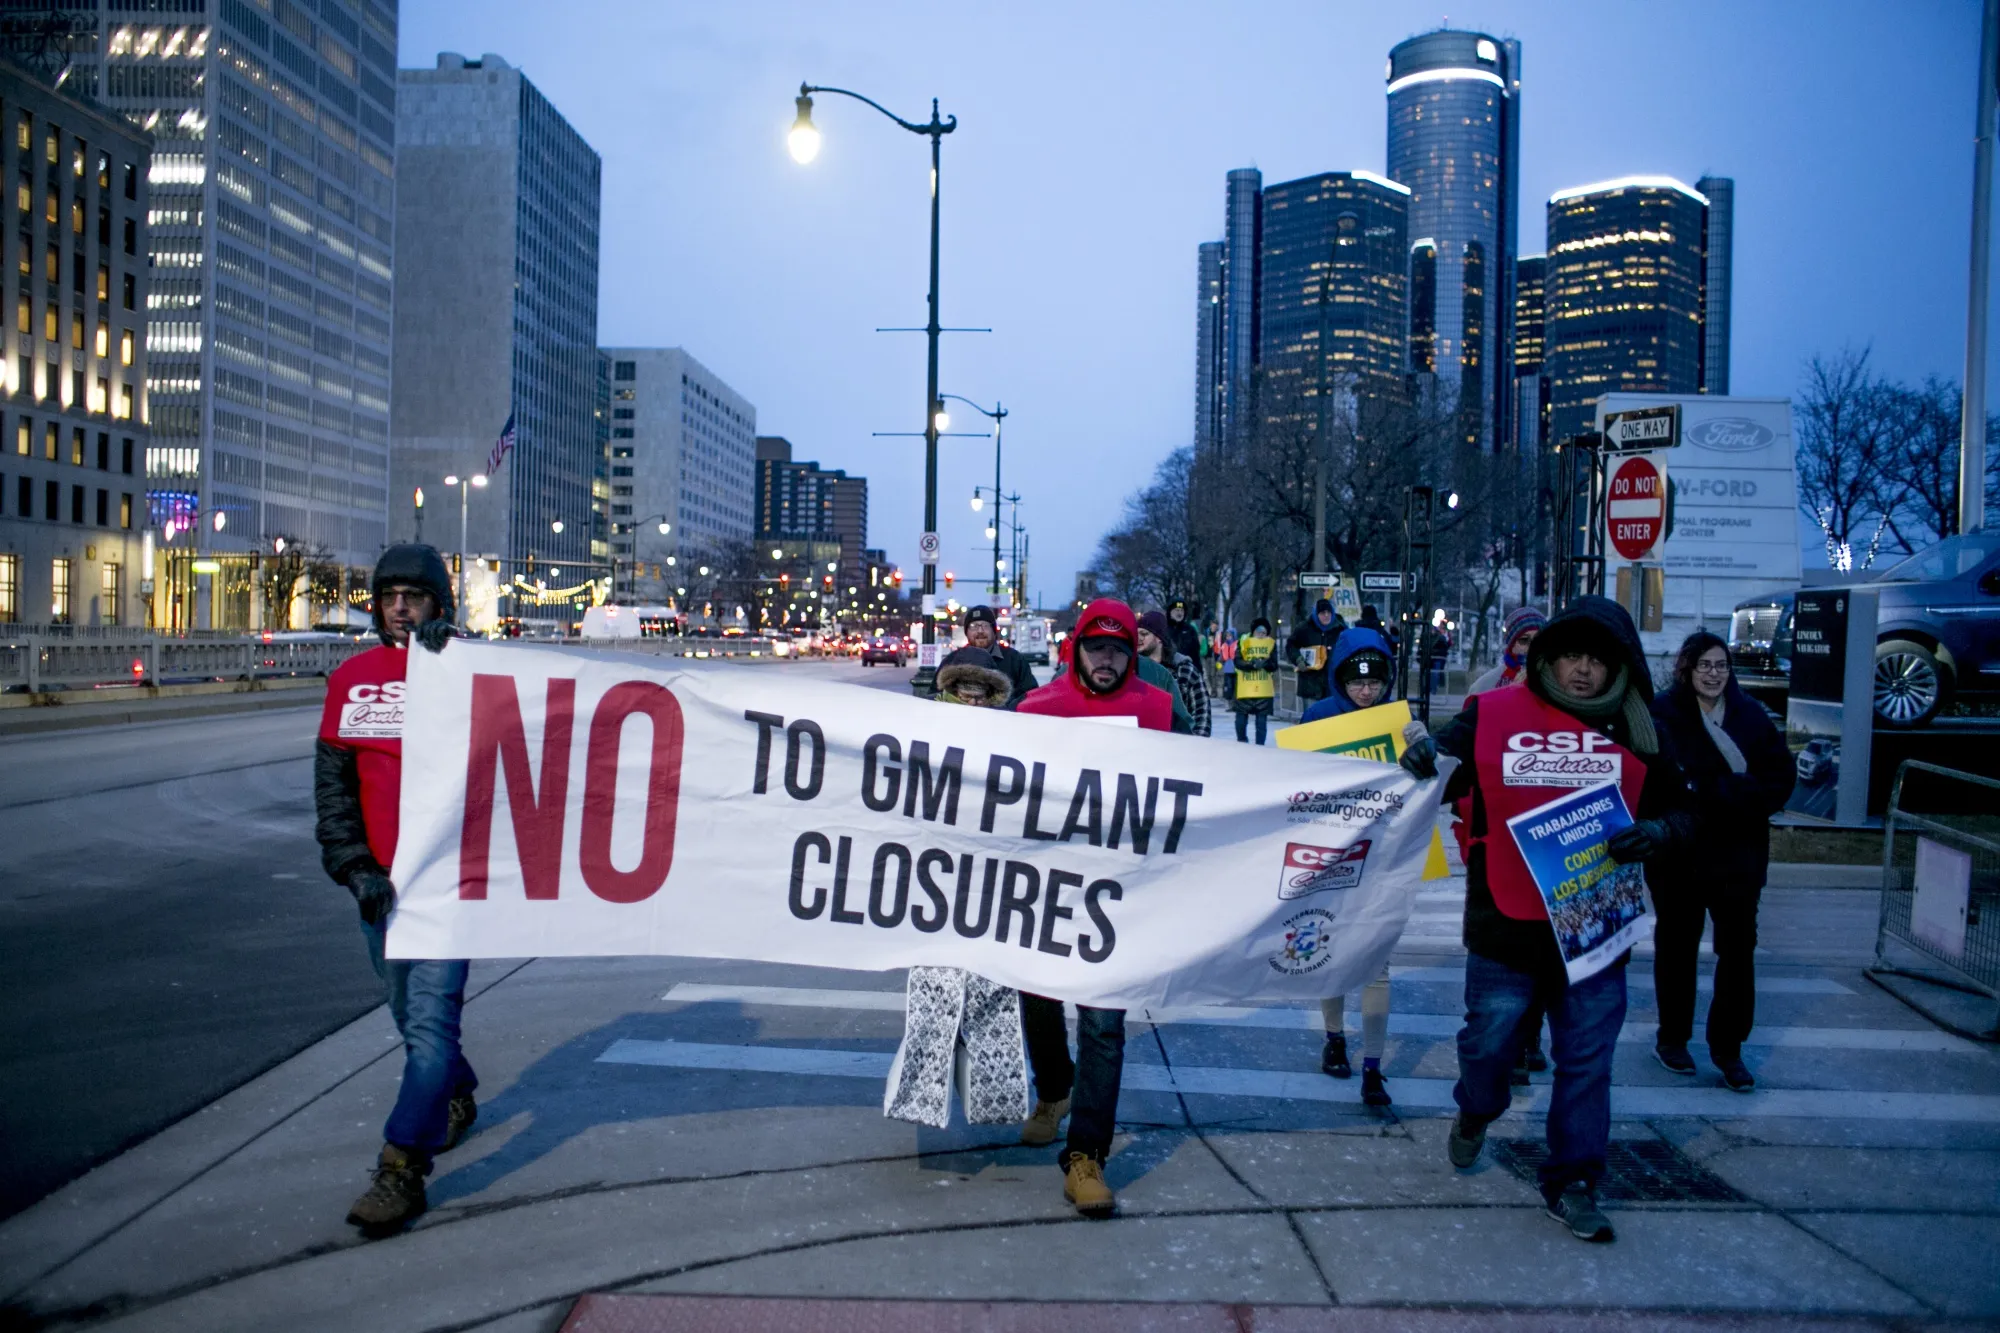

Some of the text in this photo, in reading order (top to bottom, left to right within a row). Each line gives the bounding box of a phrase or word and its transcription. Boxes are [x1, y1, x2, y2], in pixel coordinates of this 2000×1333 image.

[1621, 418, 1667, 439] ONE WAY
[1703, 421, 1759, 446] Ford
[1615, 476, 1657, 495] DO NOT
[1617, 523, 1651, 540] ENTER
[1679, 528, 1715, 537] CENTER
[1700, 517, 1752, 527] PROGRAMS
[1367, 578, 1398, 586] ONE WAY
[1358, 662, 1370, 674] S
[347, 680, 406, 704] CS
[347, 704, 404, 727] Conlu
[1507, 731, 1614, 753] CSP
[1512, 753, 1614, 775] Conlutas
[458, 672, 685, 904] NO
[744, 709, 1204, 855] TO GM PLANT
[1528, 797, 1615, 841] TRABAJADORES
[1557, 818, 1603, 847] UNIDOS
[788, 830, 1123, 964] CLOSURES
[1552, 877, 1579, 901] LOS
[1282, 908, 1337, 927] INTERNATIONAL
[1290, 953, 1332, 975] SOLIDARITY
